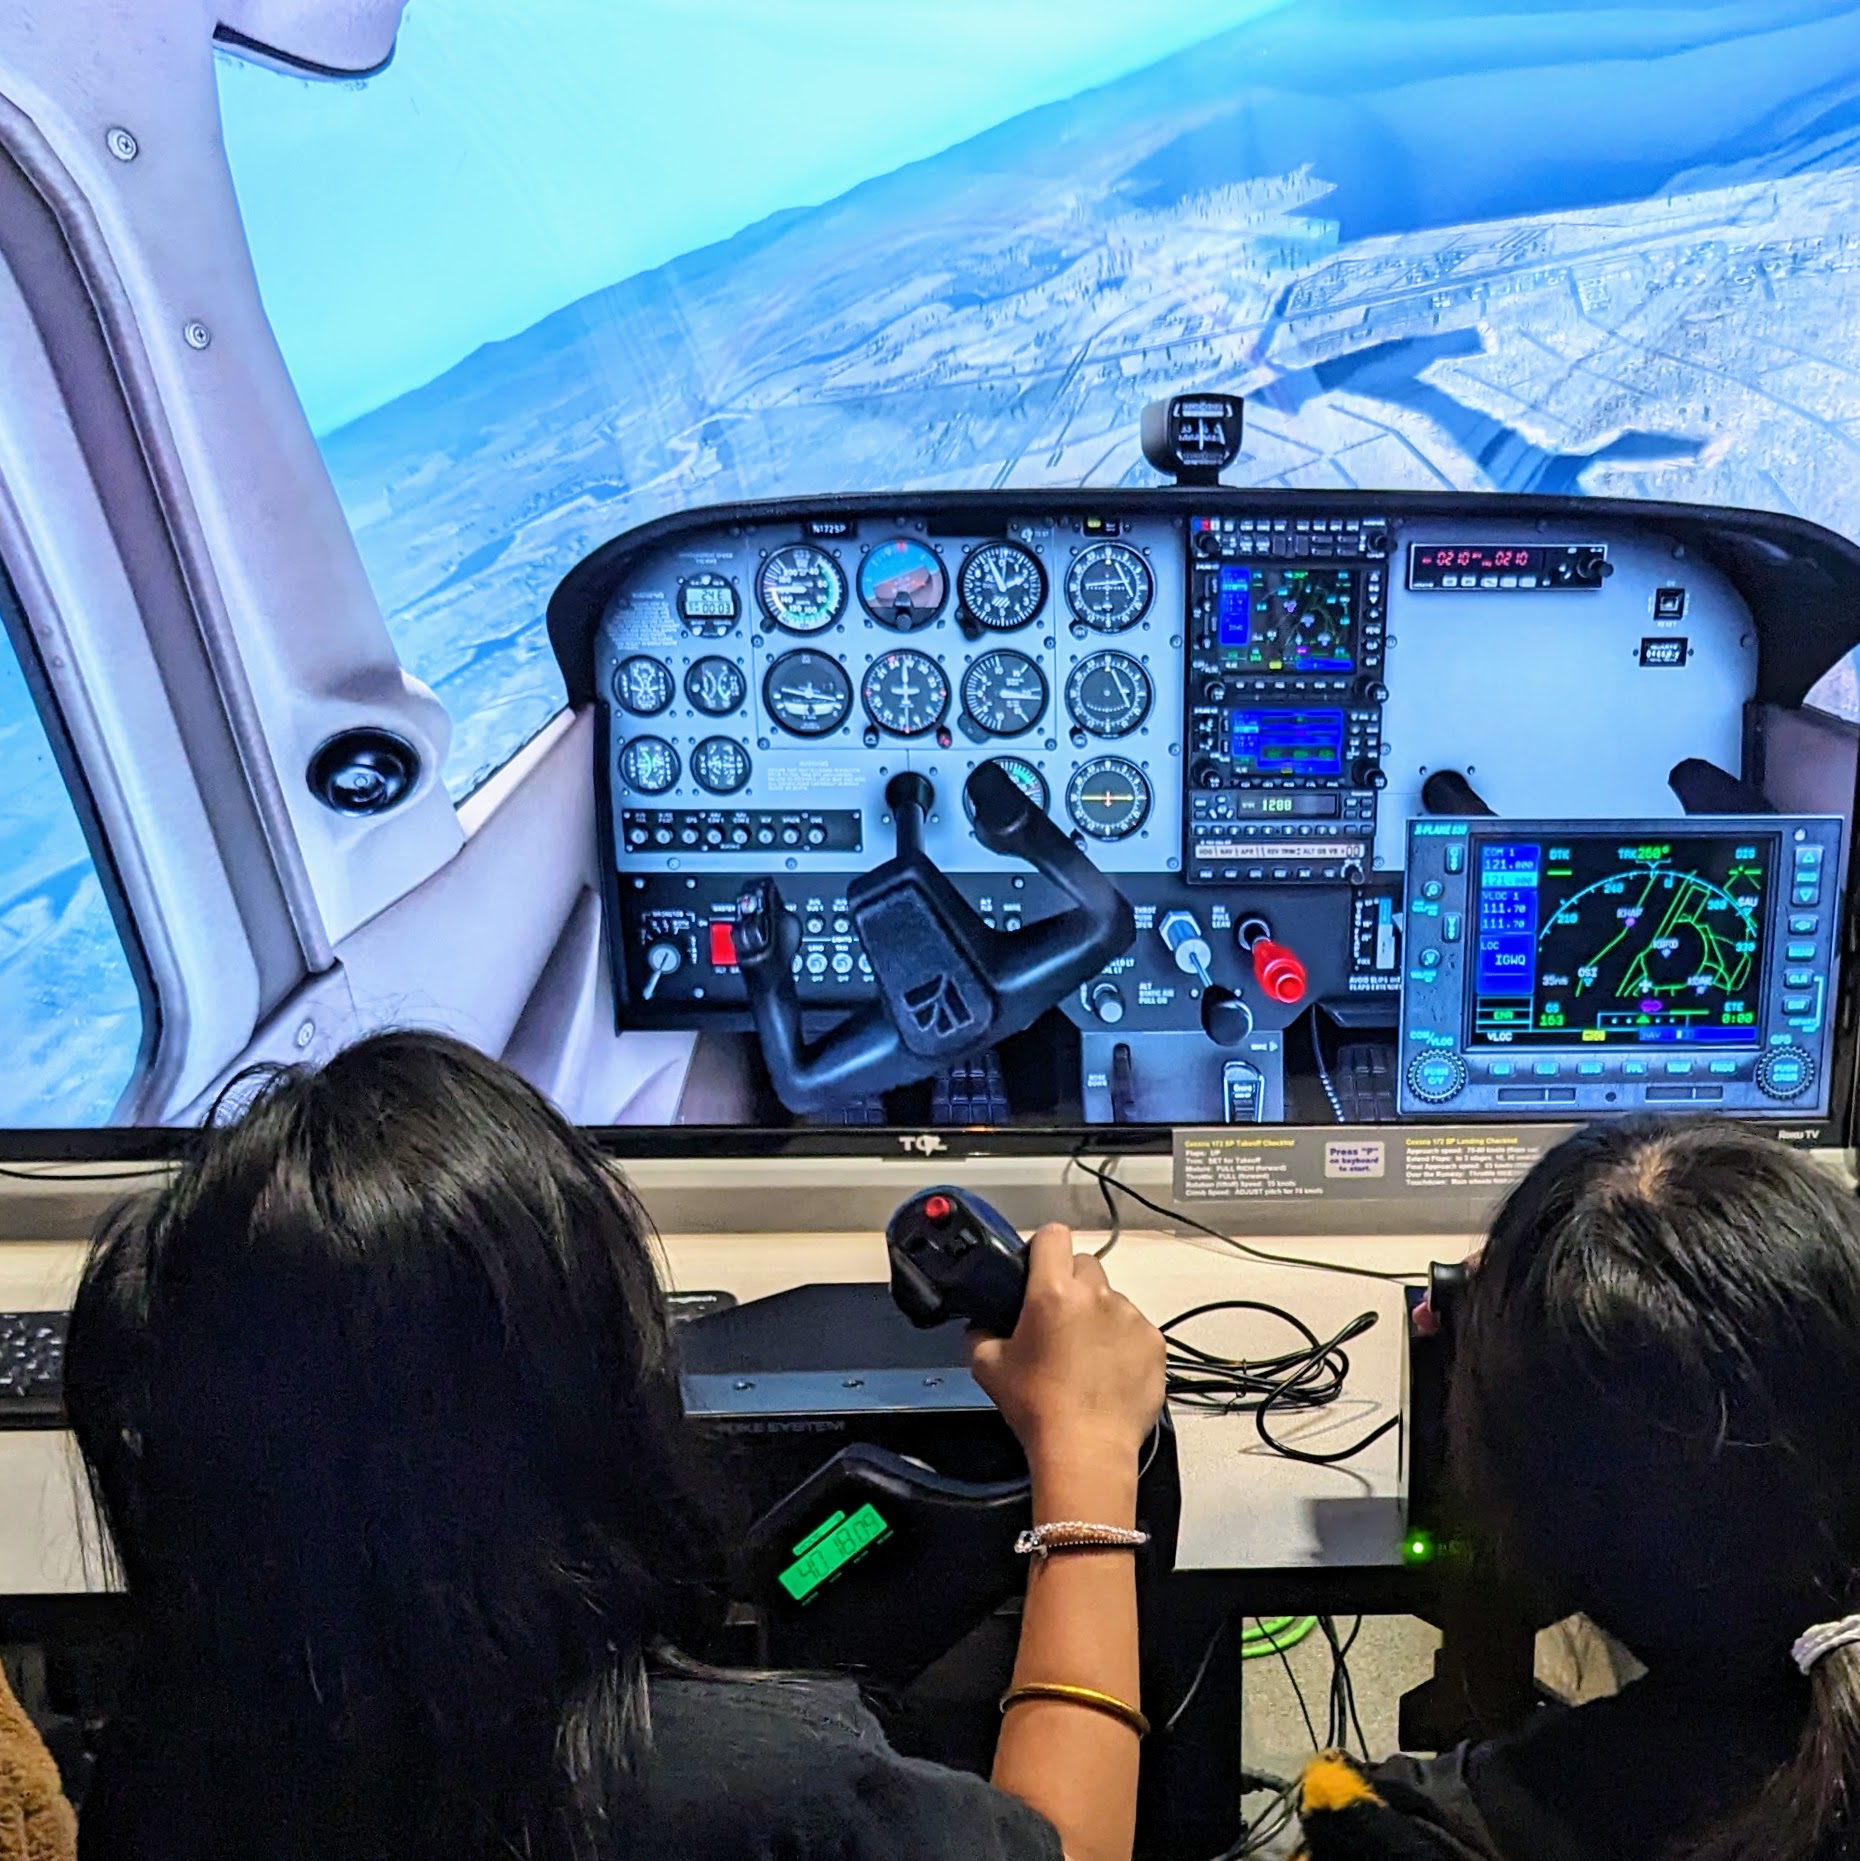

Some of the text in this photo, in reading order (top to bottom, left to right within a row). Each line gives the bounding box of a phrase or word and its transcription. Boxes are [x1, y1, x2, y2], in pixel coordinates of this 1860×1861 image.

[1262, 799, 1292, 811] 1200
[1483, 903, 1526, 914] 111.70
[1482, 919, 1525, 929] 111.70
[1495, 954, 1526, 966] IGWQ
[1788, 974, 1808, 984] CLR
[1487, 1032, 1513, 1042] VLOC
[1804, 1129, 1820, 1139] TV
[1236, 1139, 1261, 1147] Takeoff
[1262, 1138, 1295, 1146] Checklist
[1456, 1138, 1485, 1146] Landing
[1329, 1148, 1358, 1156] Press
[1341, 1156, 1379, 1165] keyboard
[1424, 1163, 1457, 1171] Approach
[1264, 1188, 1282, 1196] pitch
